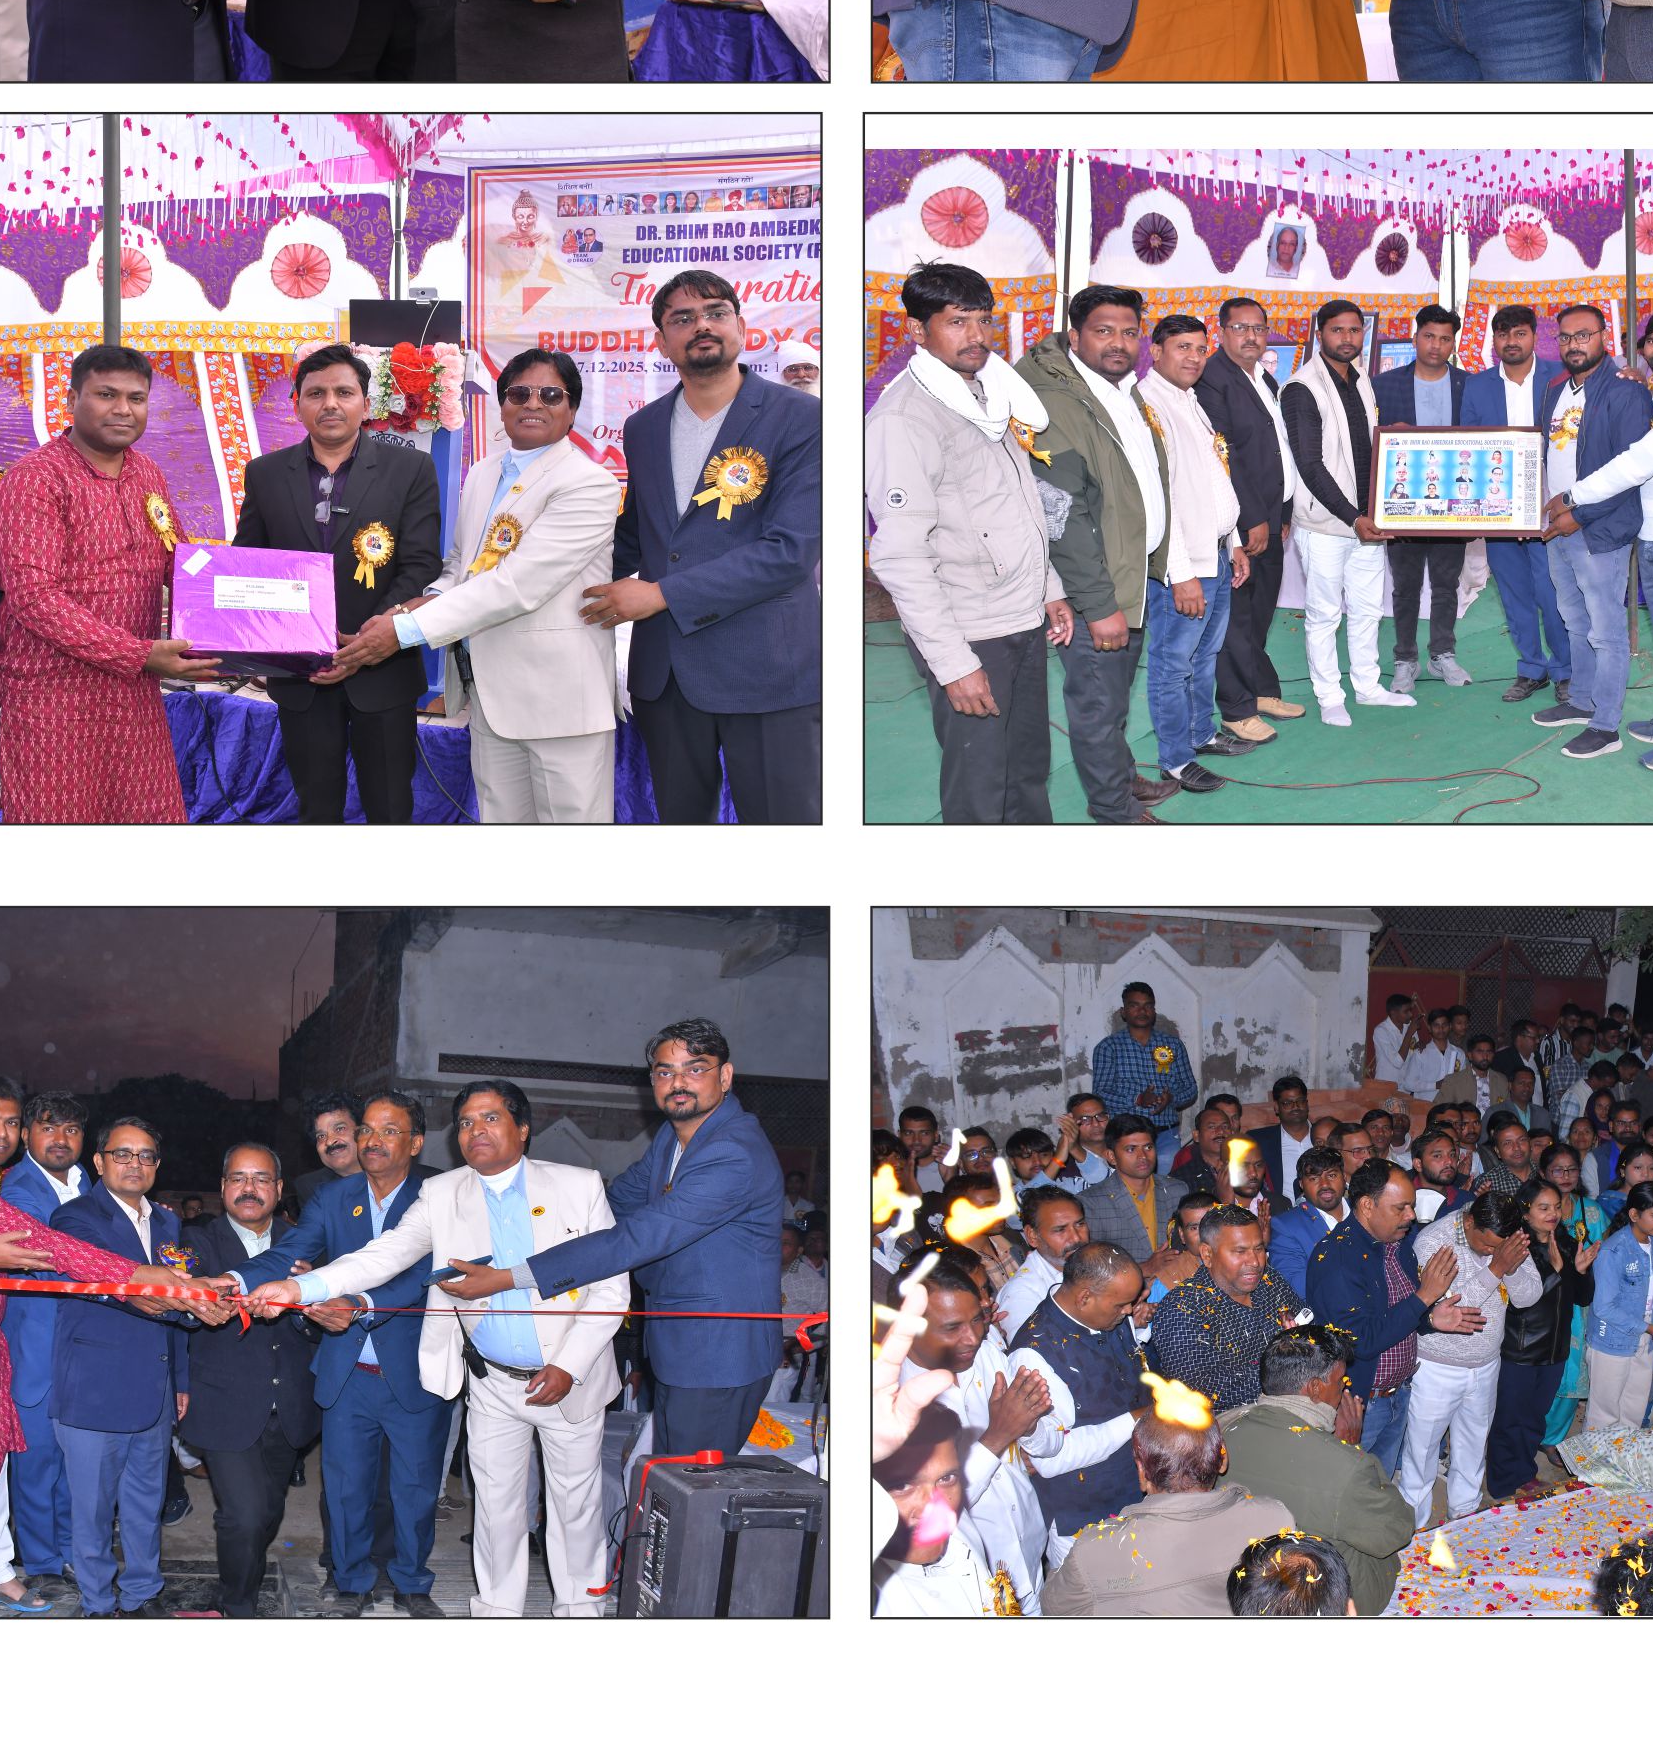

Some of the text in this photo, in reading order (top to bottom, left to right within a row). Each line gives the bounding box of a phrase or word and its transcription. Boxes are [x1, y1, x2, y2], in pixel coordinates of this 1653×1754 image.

[636, 225, 661, 242] DR.
[665, 223, 709, 240] BHIM
[712, 221, 746, 239] RAO
[622, 244, 803, 264] EDUCATIONAL SOCIETY
